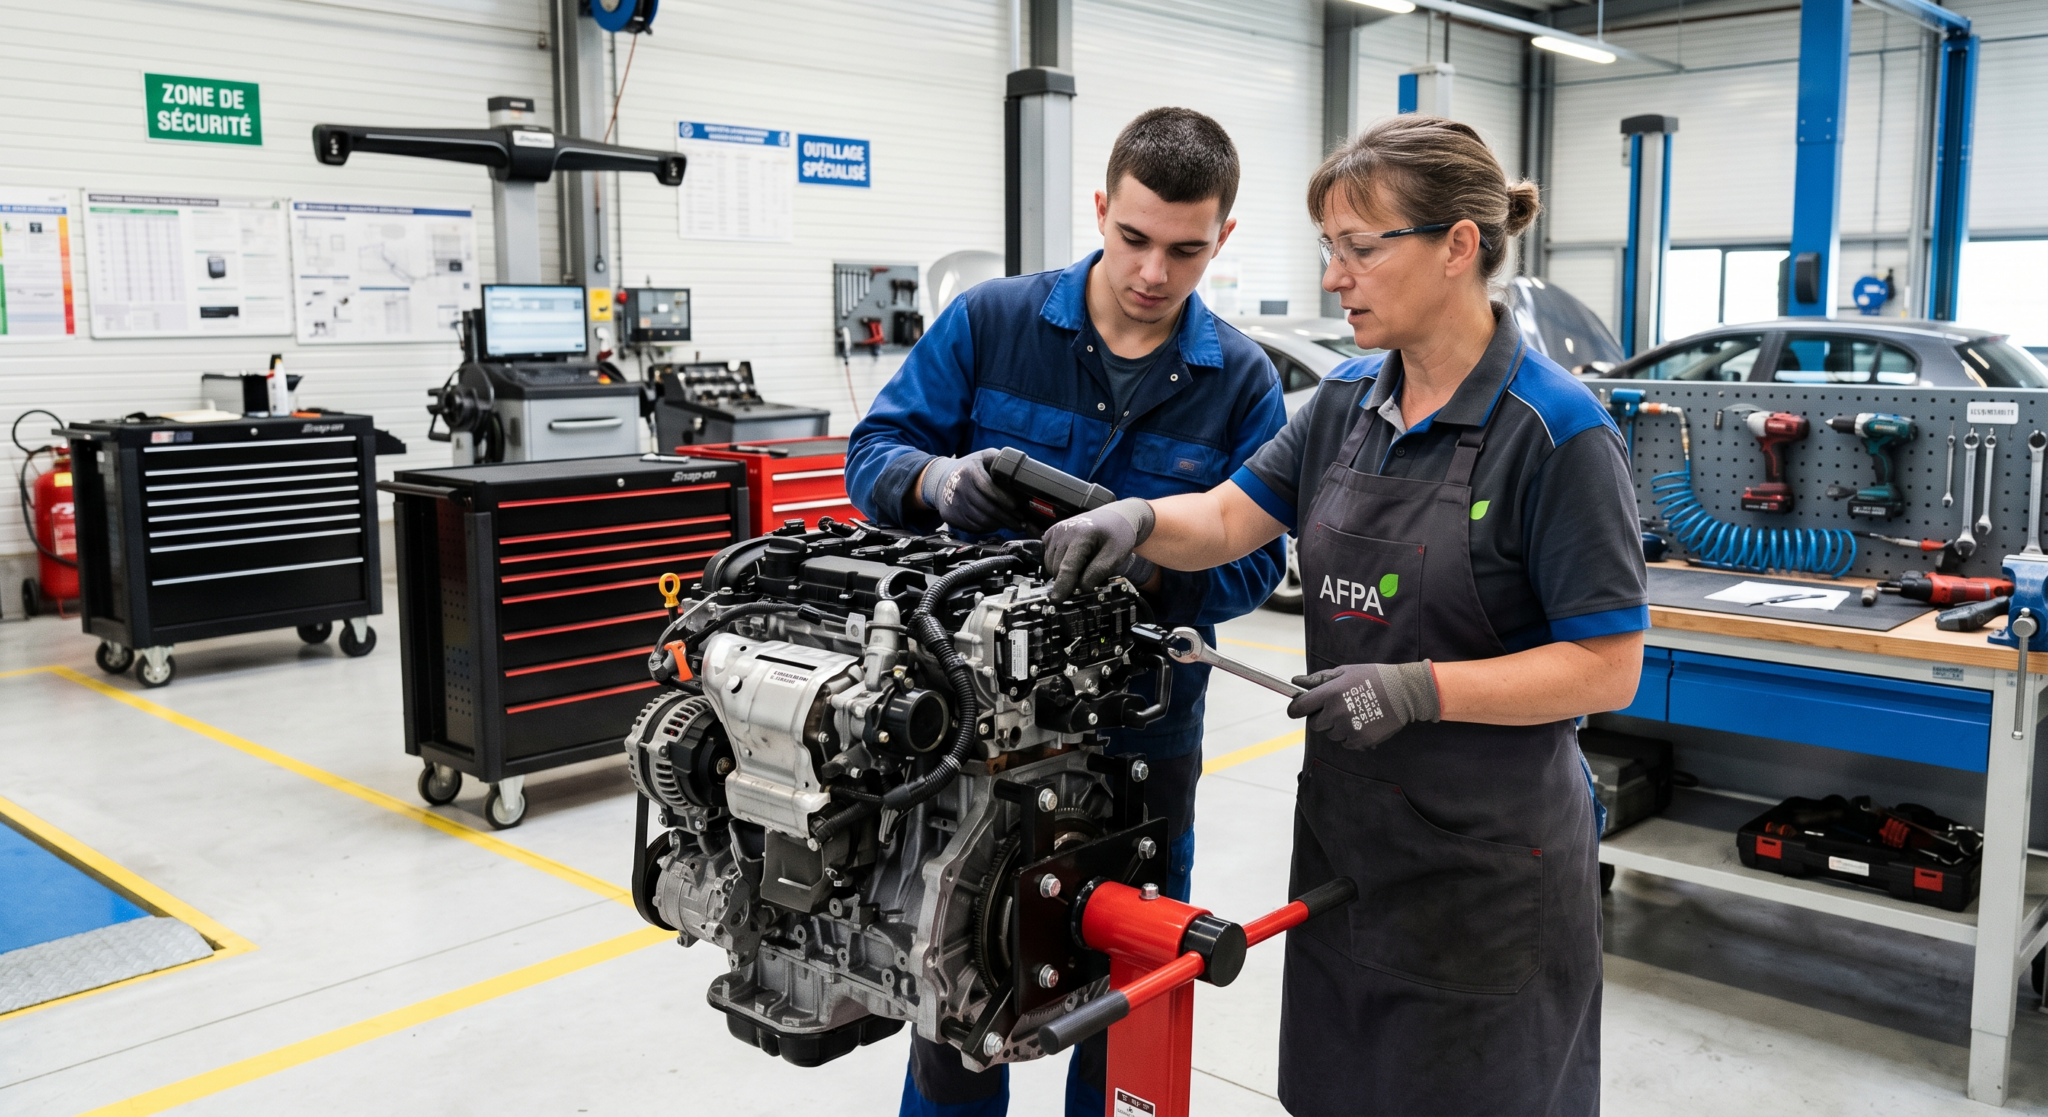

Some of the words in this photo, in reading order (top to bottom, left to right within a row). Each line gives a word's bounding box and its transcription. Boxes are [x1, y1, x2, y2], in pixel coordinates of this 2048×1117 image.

[162, 83, 215, 107] ZONE
[219, 88, 245, 110] DE
[157, 107, 252, 137] SÉCURITÉ
[803, 140, 865, 161] OUTILLAGE
[802, 159, 867, 181] SPÉCIALISÉ
[671, 470, 717, 483] Snap-on
[1319, 574, 1385, 616] AFPA
